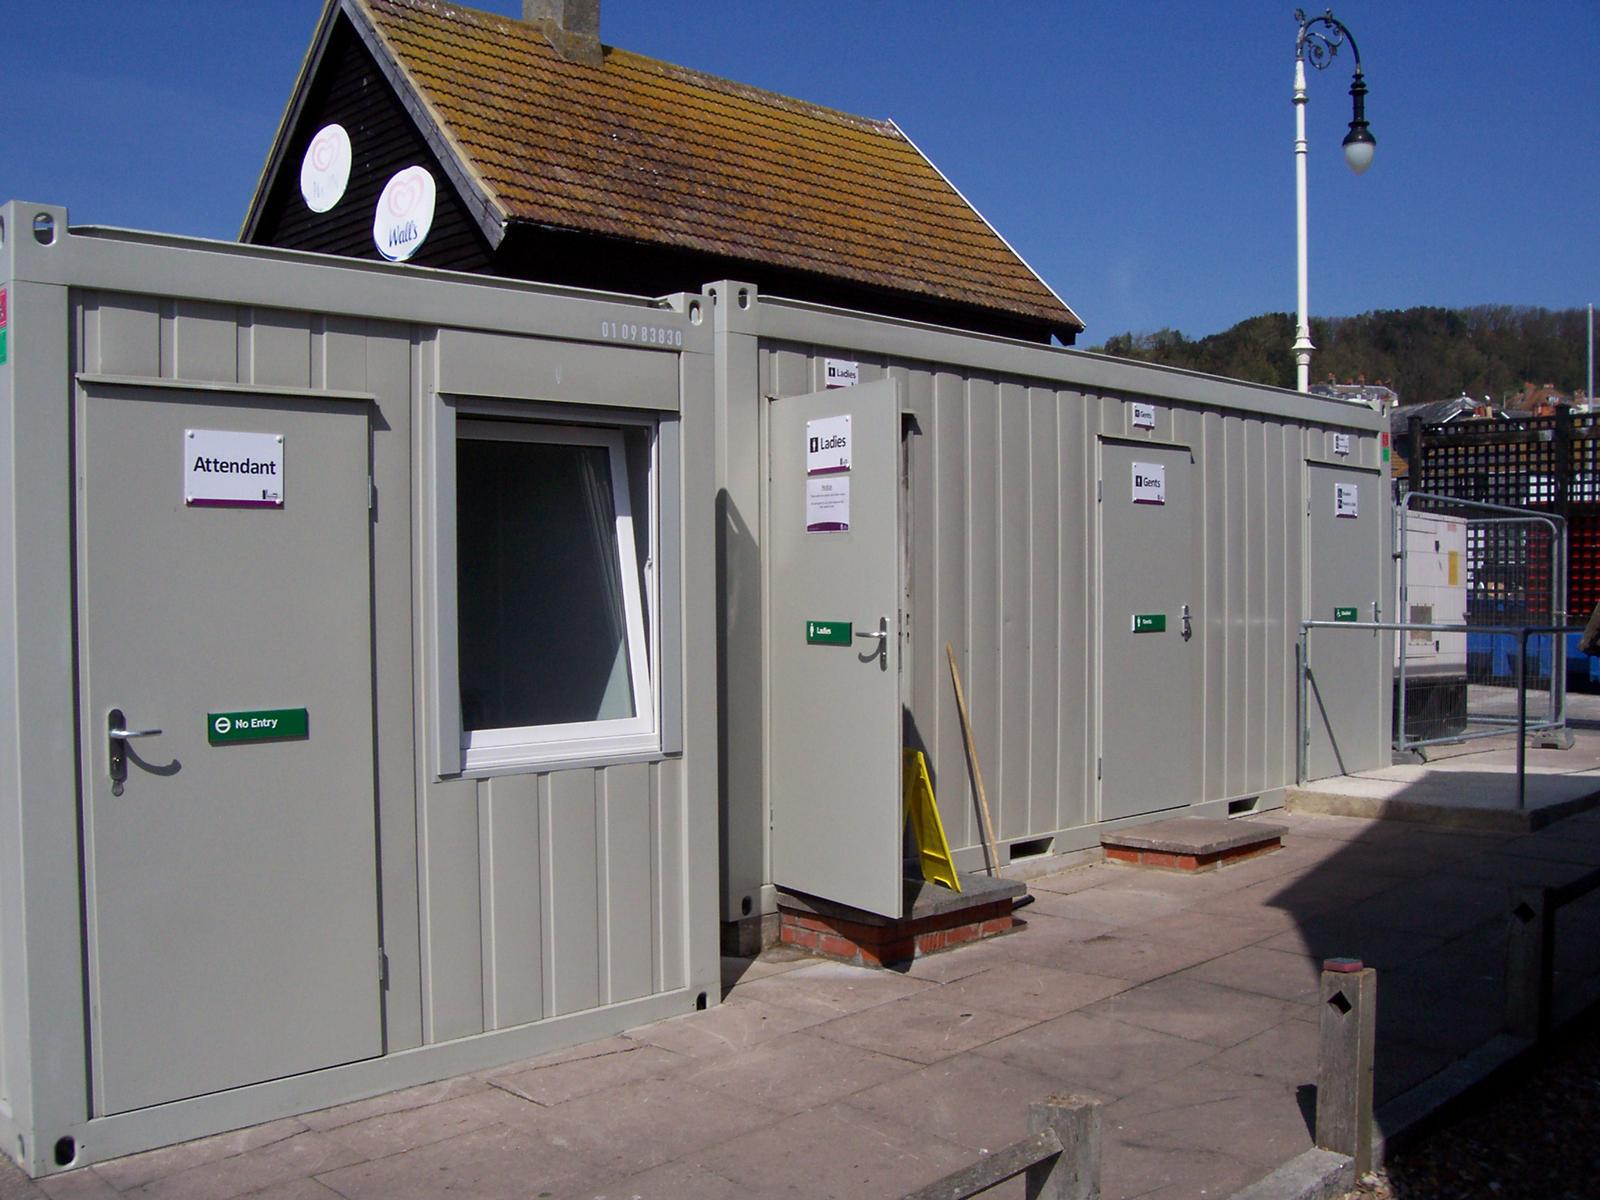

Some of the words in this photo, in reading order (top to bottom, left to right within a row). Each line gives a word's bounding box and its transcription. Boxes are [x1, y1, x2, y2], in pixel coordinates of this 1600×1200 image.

[389, 219, 418, 248] Wall's
[837, 368, 857, 379] Ladies
[820, 435, 847, 451] Ladies
[193, 456, 276, 475] Attendant
[1143, 477, 1161, 488] Gents
[235, 719, 249, 729] No
[251, 718, 278, 729] Entry
